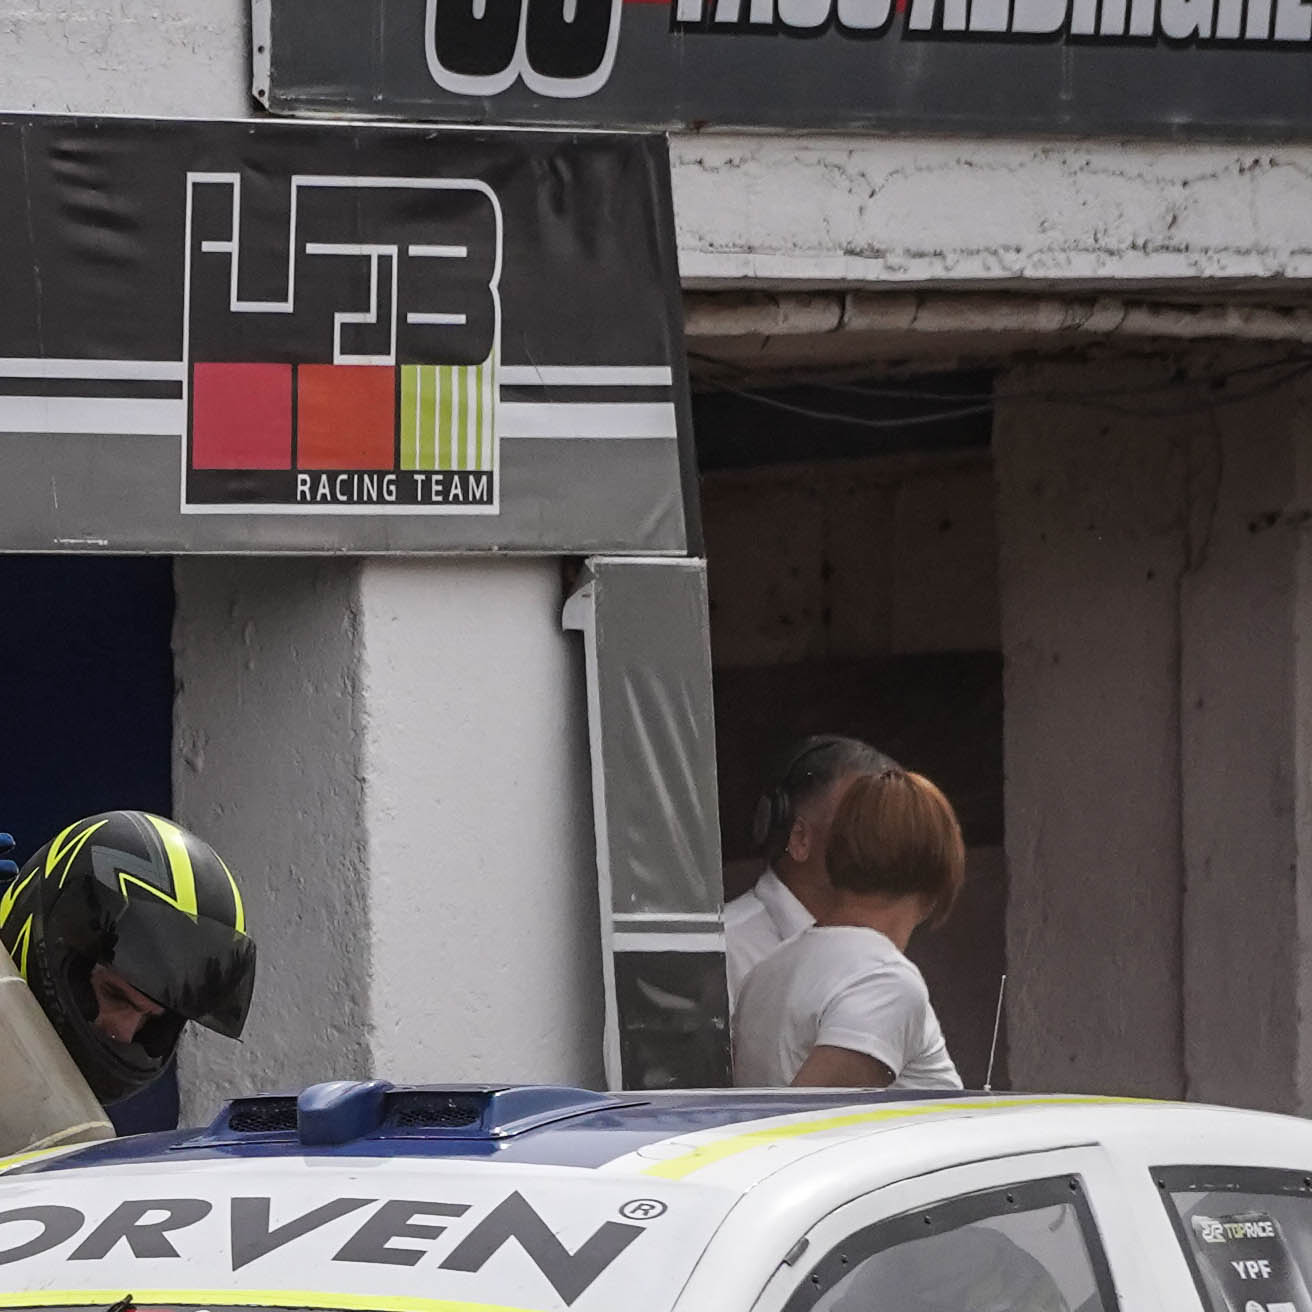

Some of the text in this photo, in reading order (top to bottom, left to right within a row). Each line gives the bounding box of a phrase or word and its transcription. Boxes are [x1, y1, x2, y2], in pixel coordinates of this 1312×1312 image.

[296, 473, 489, 502] RACING TEAM
[1231, 1259, 1273, 1280] YPF
